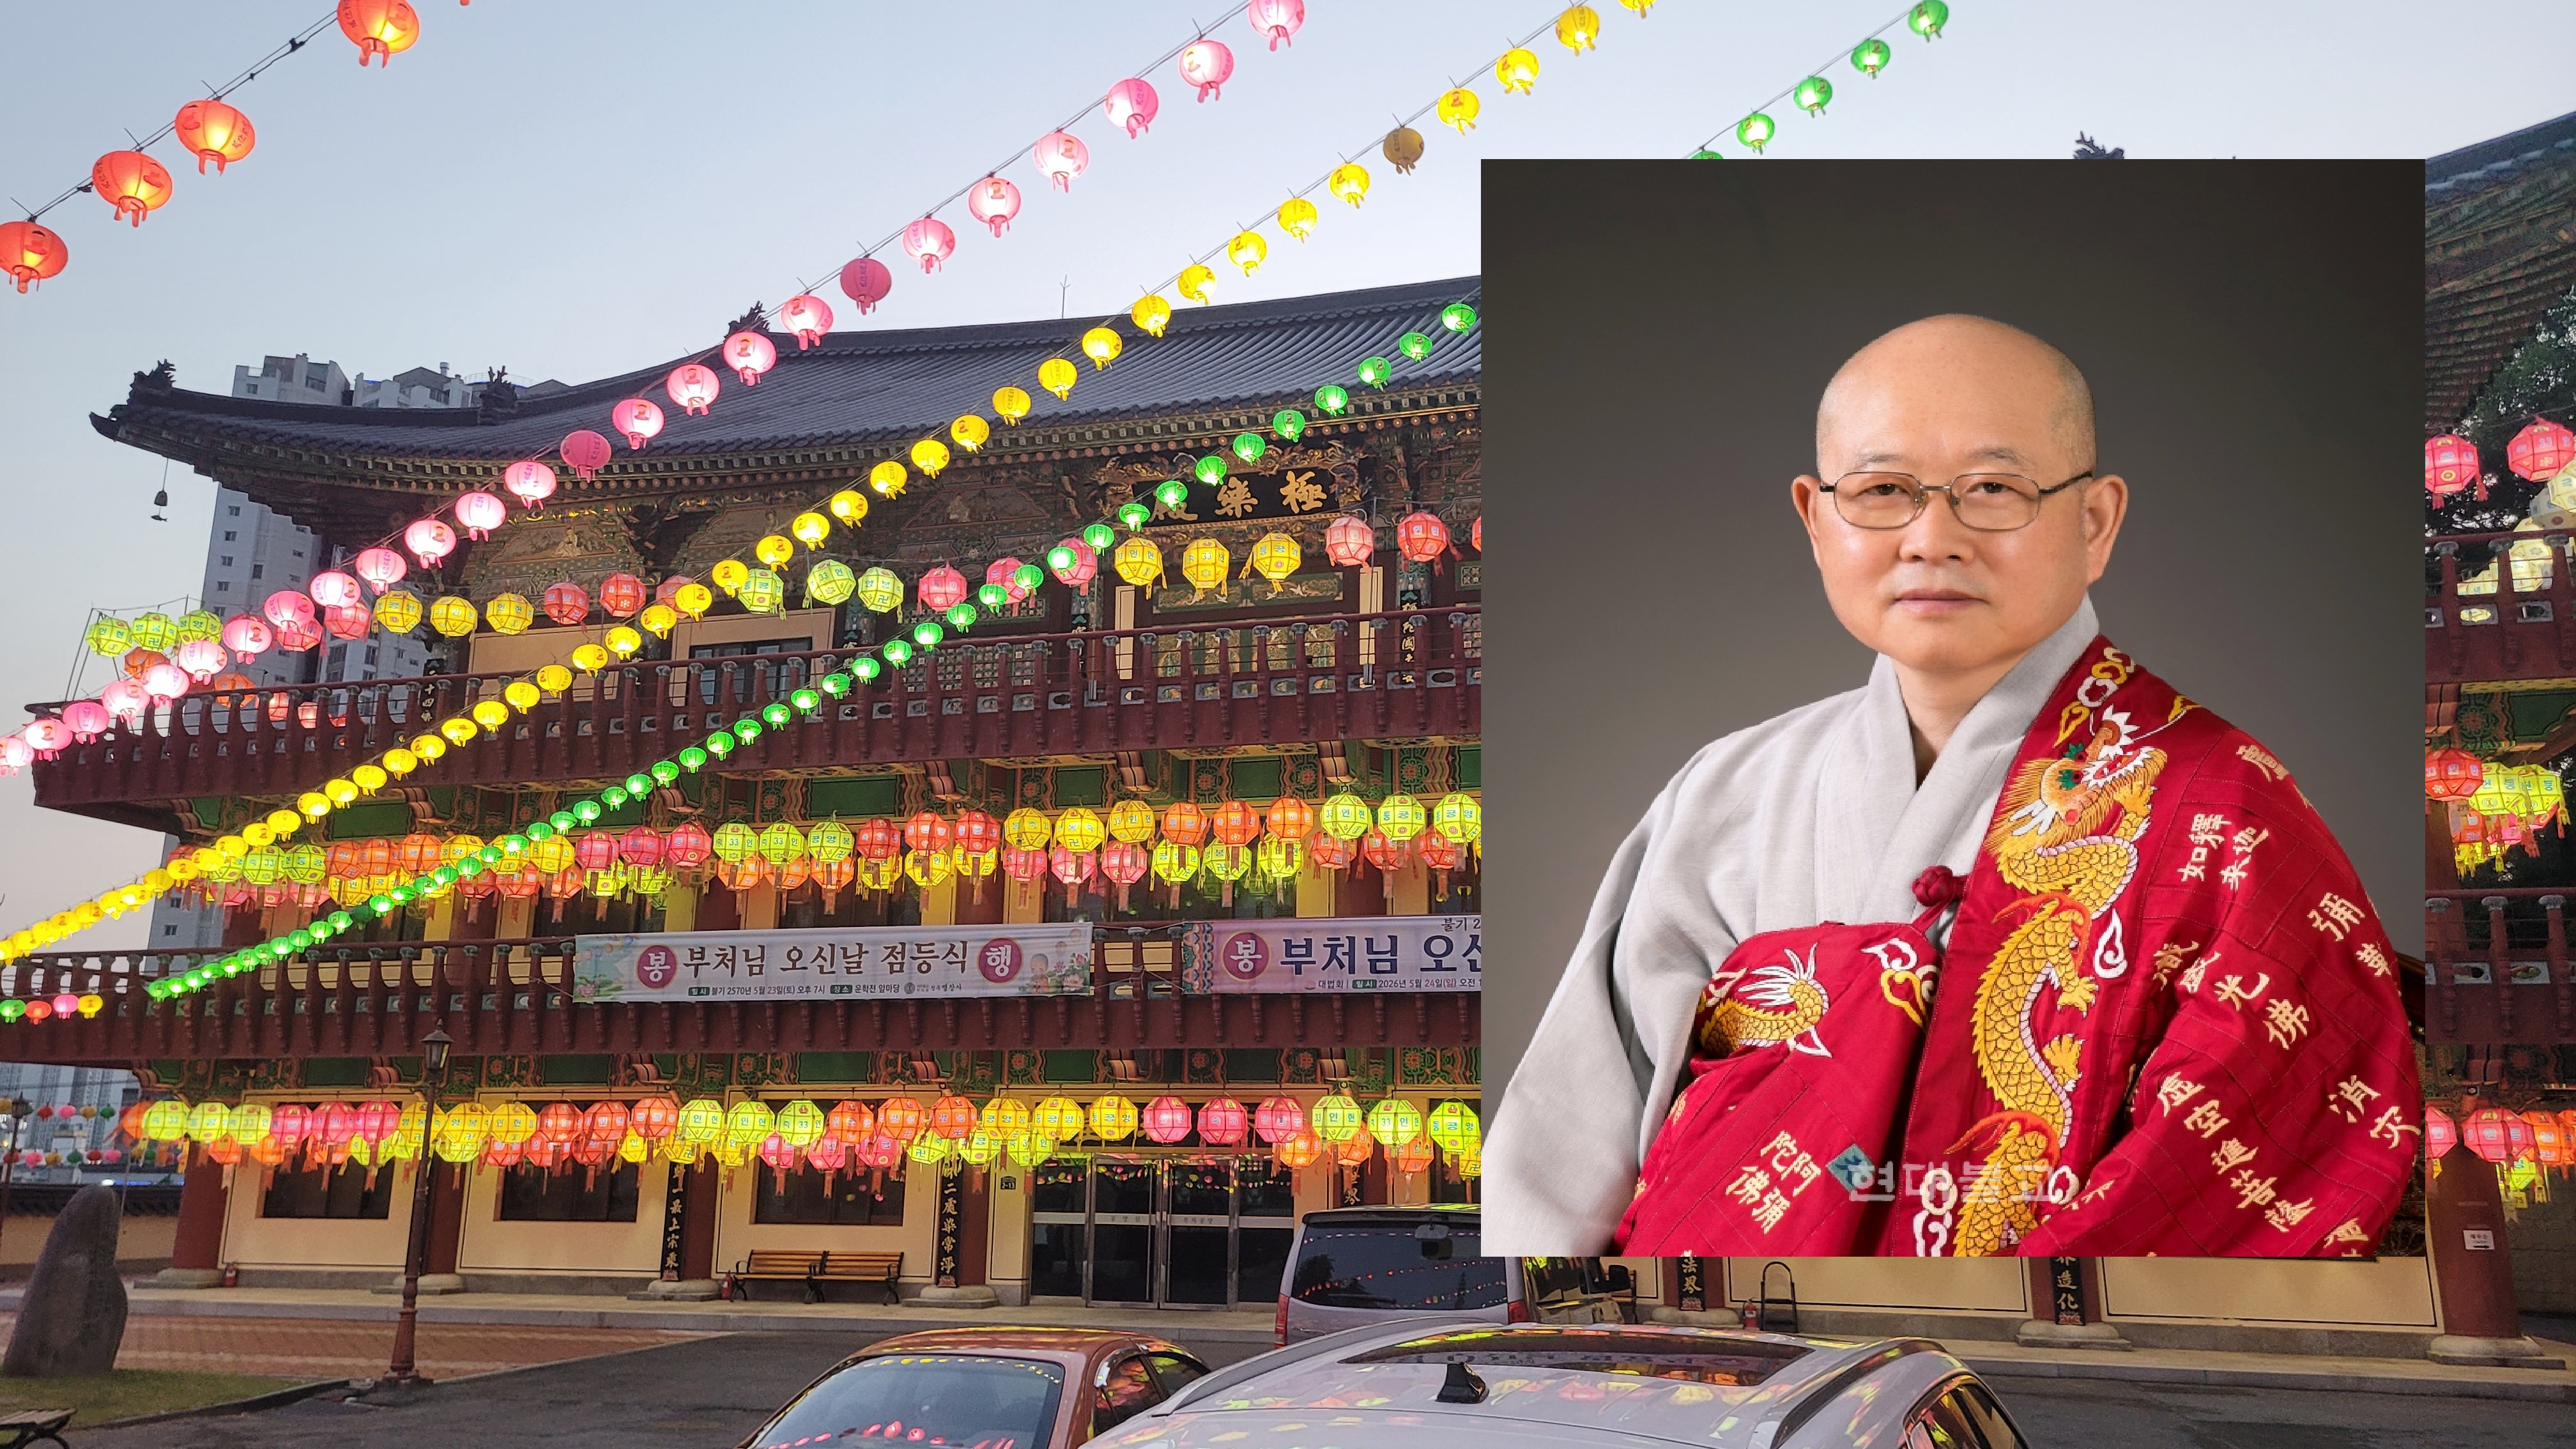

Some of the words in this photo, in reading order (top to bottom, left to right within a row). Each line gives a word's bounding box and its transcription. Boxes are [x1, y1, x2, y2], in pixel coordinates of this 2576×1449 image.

[1441, 917, 1467, 932] 불기
[643, 949, 670, 983] 봉
[683, 947, 765, 978] 부처님
[779, 943, 869, 976] 오신날
[880, 940, 969, 974] 점등식
[985, 946, 1012, 978] 행
[1230, 940, 1262, 972] 봉
[1280, 935, 1398, 974] 부처님
[727, 986, 751, 995] 2570년
[754, 986, 765, 995] 5월
[767, 986, 795, 995] 23일(토)
[797, 986, 811, 994] 오후
[814, 985, 825, 994] 7시
[878, 984, 900, 993] 앞마당
[1318, 979, 1344, 988] 대법회
[1378, 979, 1406, 988] 2026년
[1409, 979, 1422, 988] 5월
[1424, 978, 1457, 988] 24일(일)
[1459, 978, 1475, 988] 오전
